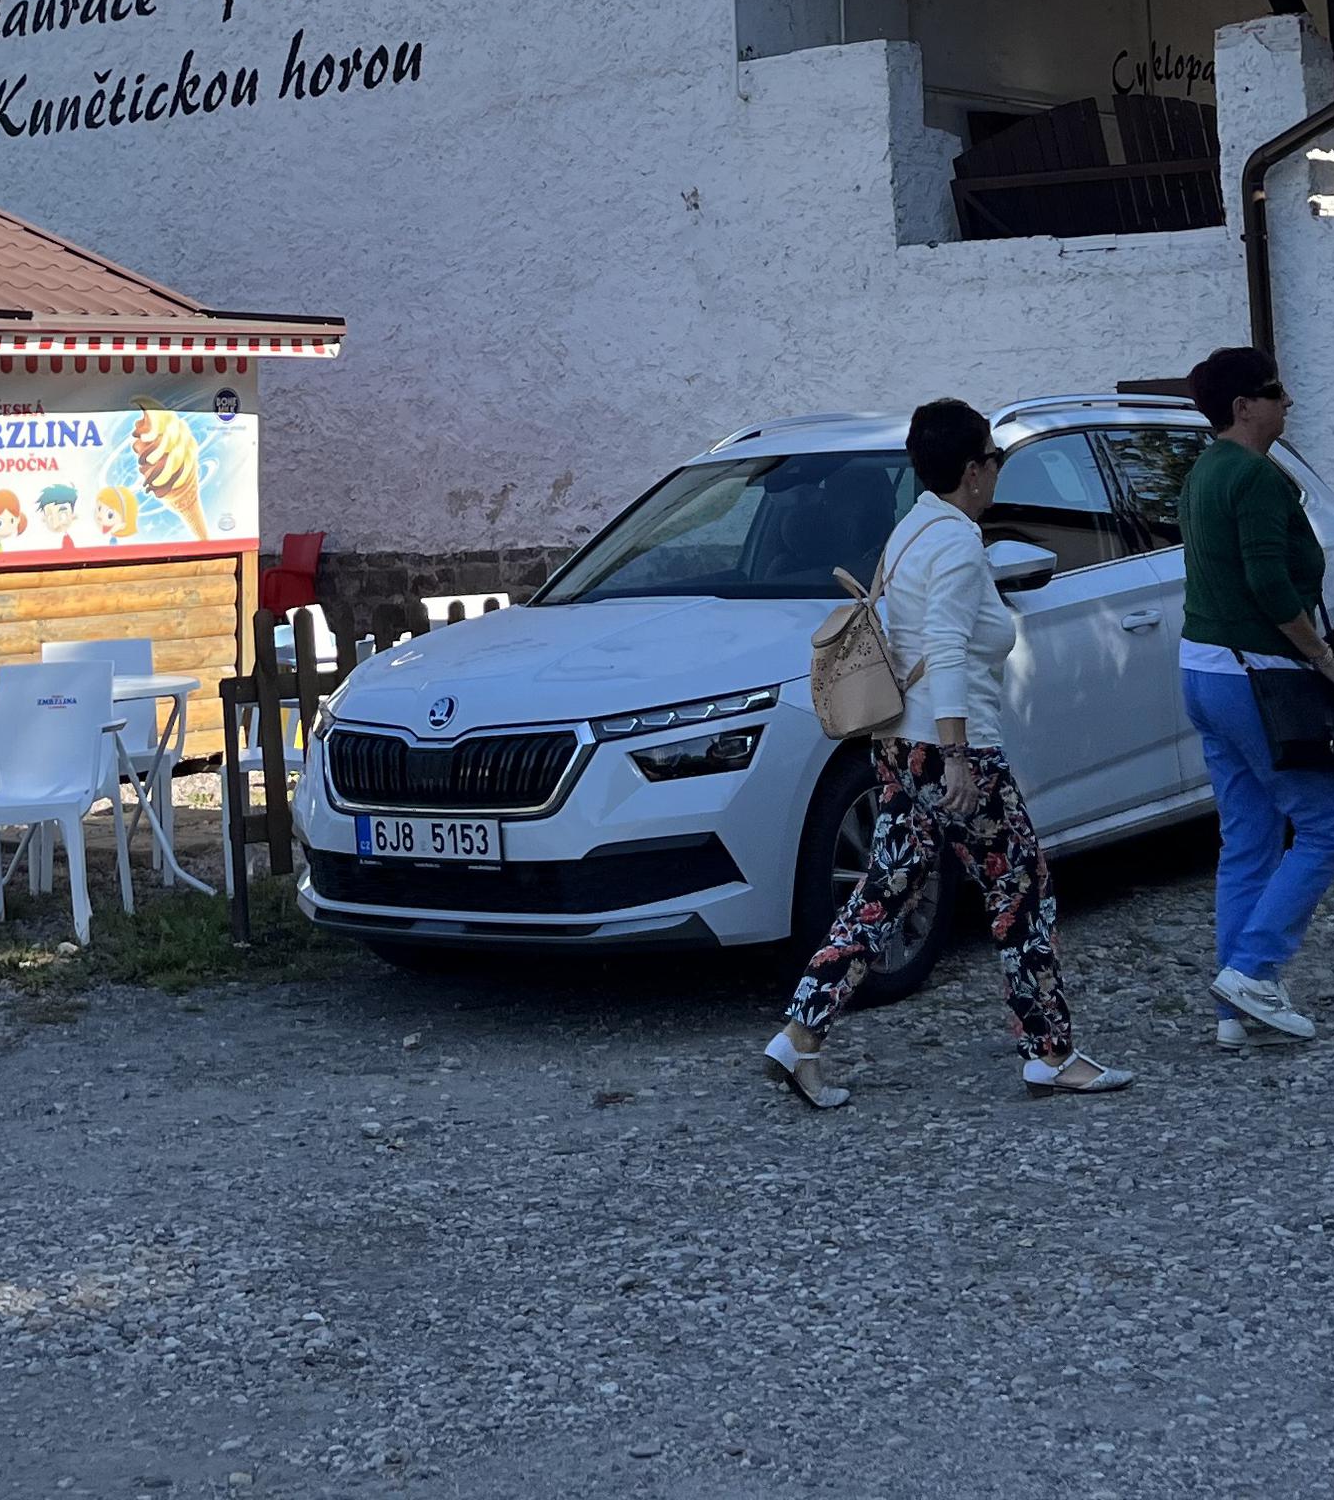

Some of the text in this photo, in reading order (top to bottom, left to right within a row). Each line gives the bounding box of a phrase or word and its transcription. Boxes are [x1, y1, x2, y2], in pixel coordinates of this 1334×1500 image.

[278, 28, 423, 99] horou
[375, 820, 414, 852] 6J8
[431, 822, 489, 855] 5153
